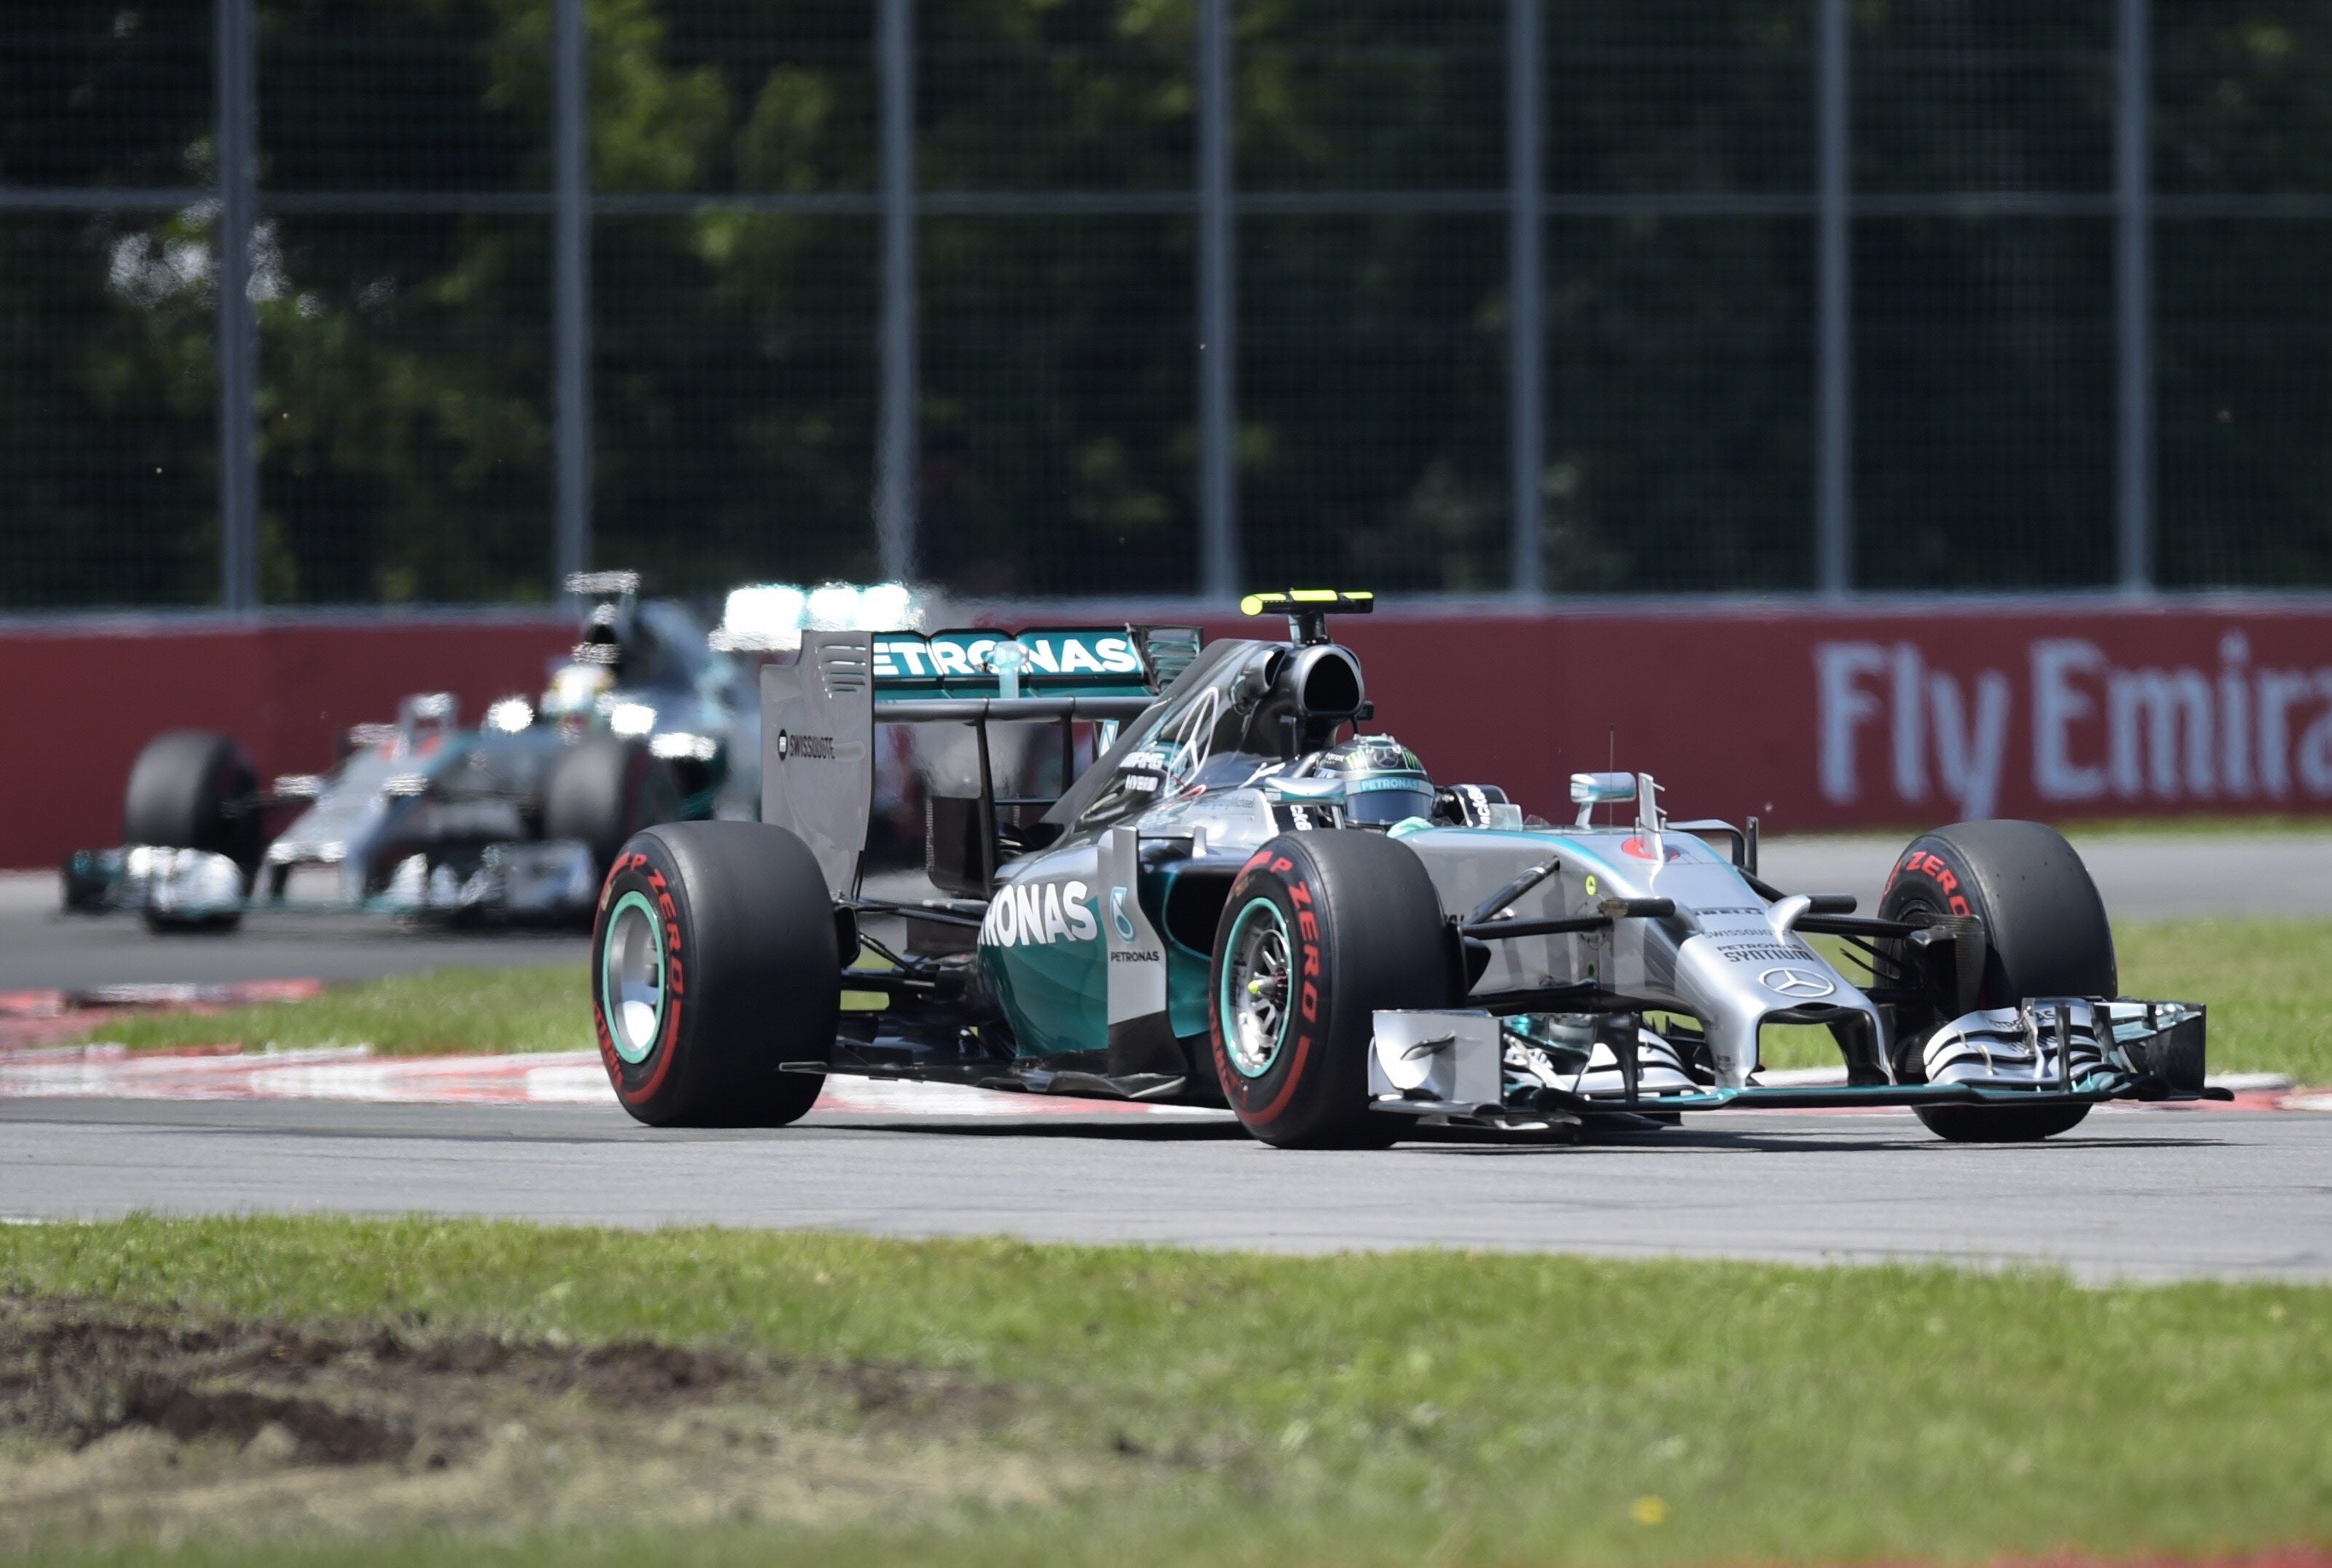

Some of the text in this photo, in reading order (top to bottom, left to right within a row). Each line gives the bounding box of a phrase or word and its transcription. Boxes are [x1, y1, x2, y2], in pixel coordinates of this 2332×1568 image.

[874, 639, 1136, 675] ETRONAS
[790, 734, 835, 759] SWISSQUOTE
[1817, 641, 2010, 821] Fly
[1361, 778, 1419, 791] PETRONAS
[1906, 850, 1972, 917] ZERO
[648, 868, 684, 994] ZERO
[977, 881, 1098, 947] RONAS
[1110, 951, 1159, 962] PETRONAS
[1288, 881, 1320, 1023] ZERO
[1723, 949, 1815, 962] SYNTIUM
